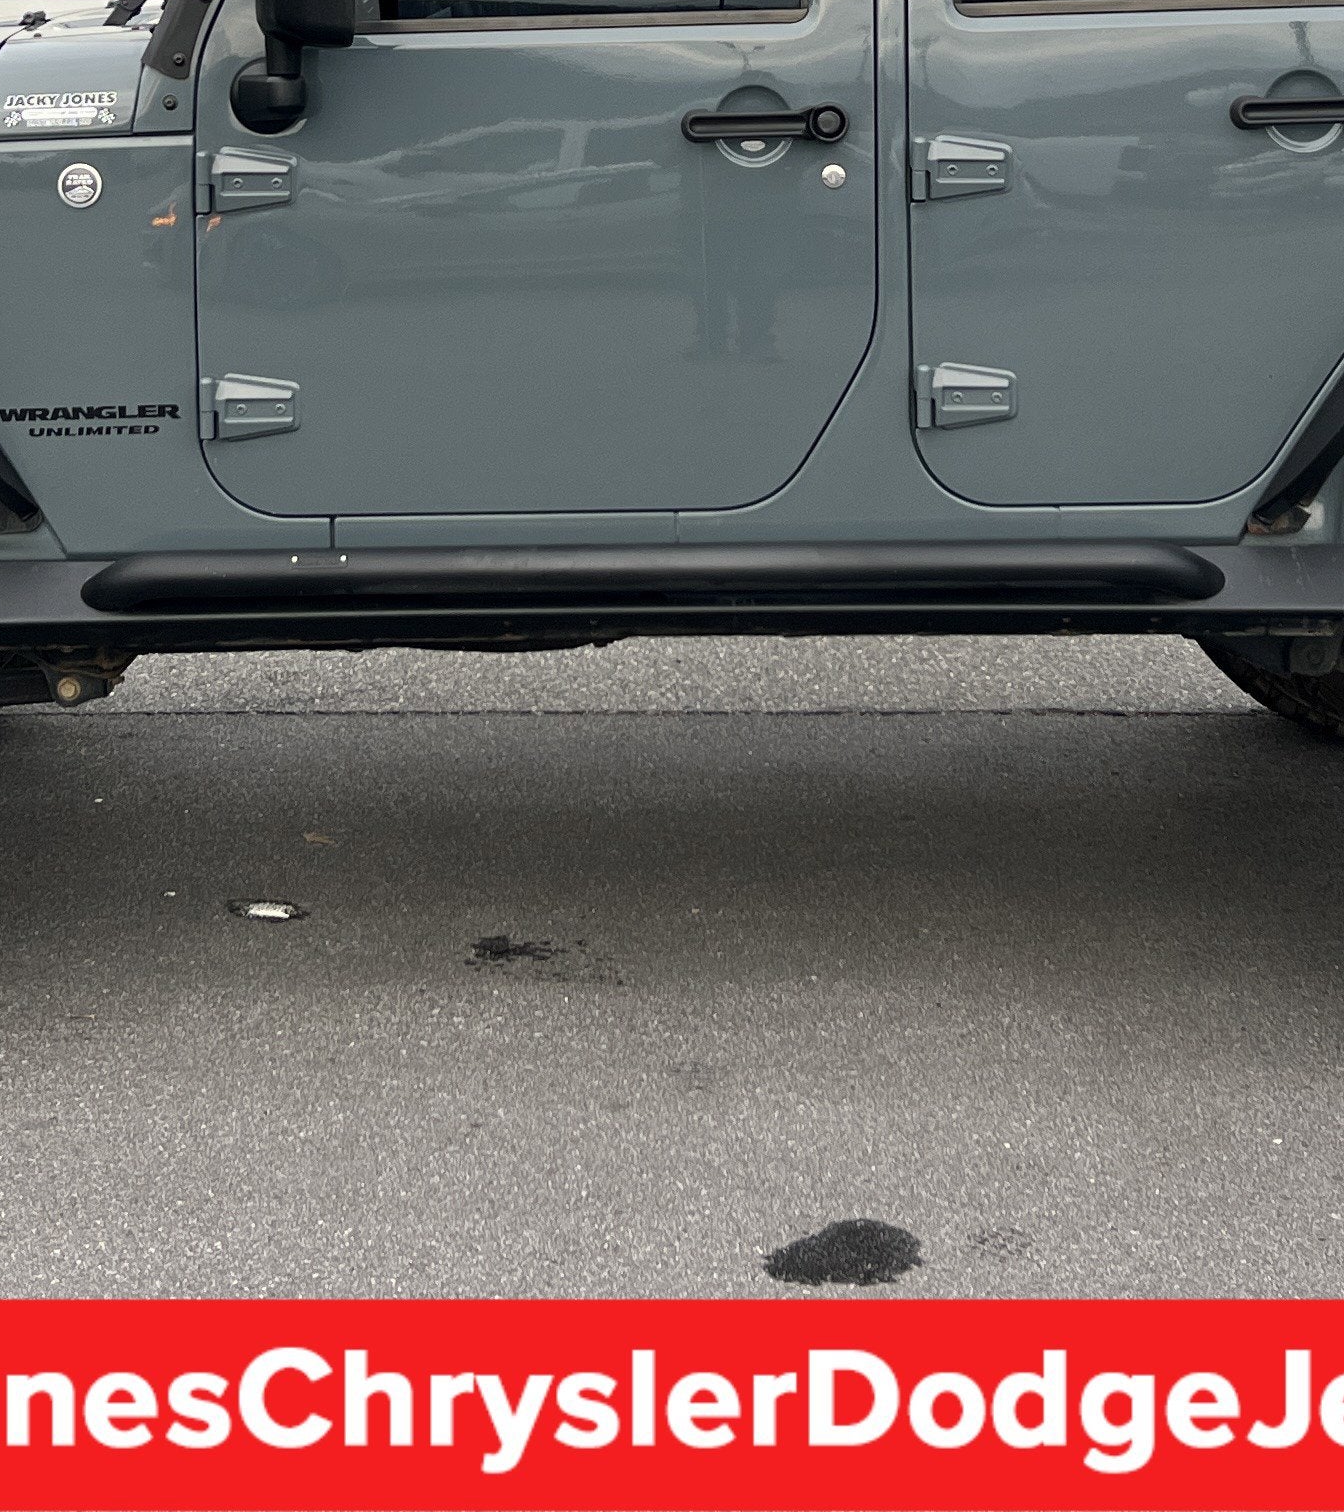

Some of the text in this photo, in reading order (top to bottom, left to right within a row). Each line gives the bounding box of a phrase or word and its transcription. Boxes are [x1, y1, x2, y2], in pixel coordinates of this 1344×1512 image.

[4, 92, 117, 108] JACKY JONES
[29, 424, 161, 438] UNLIMITED
